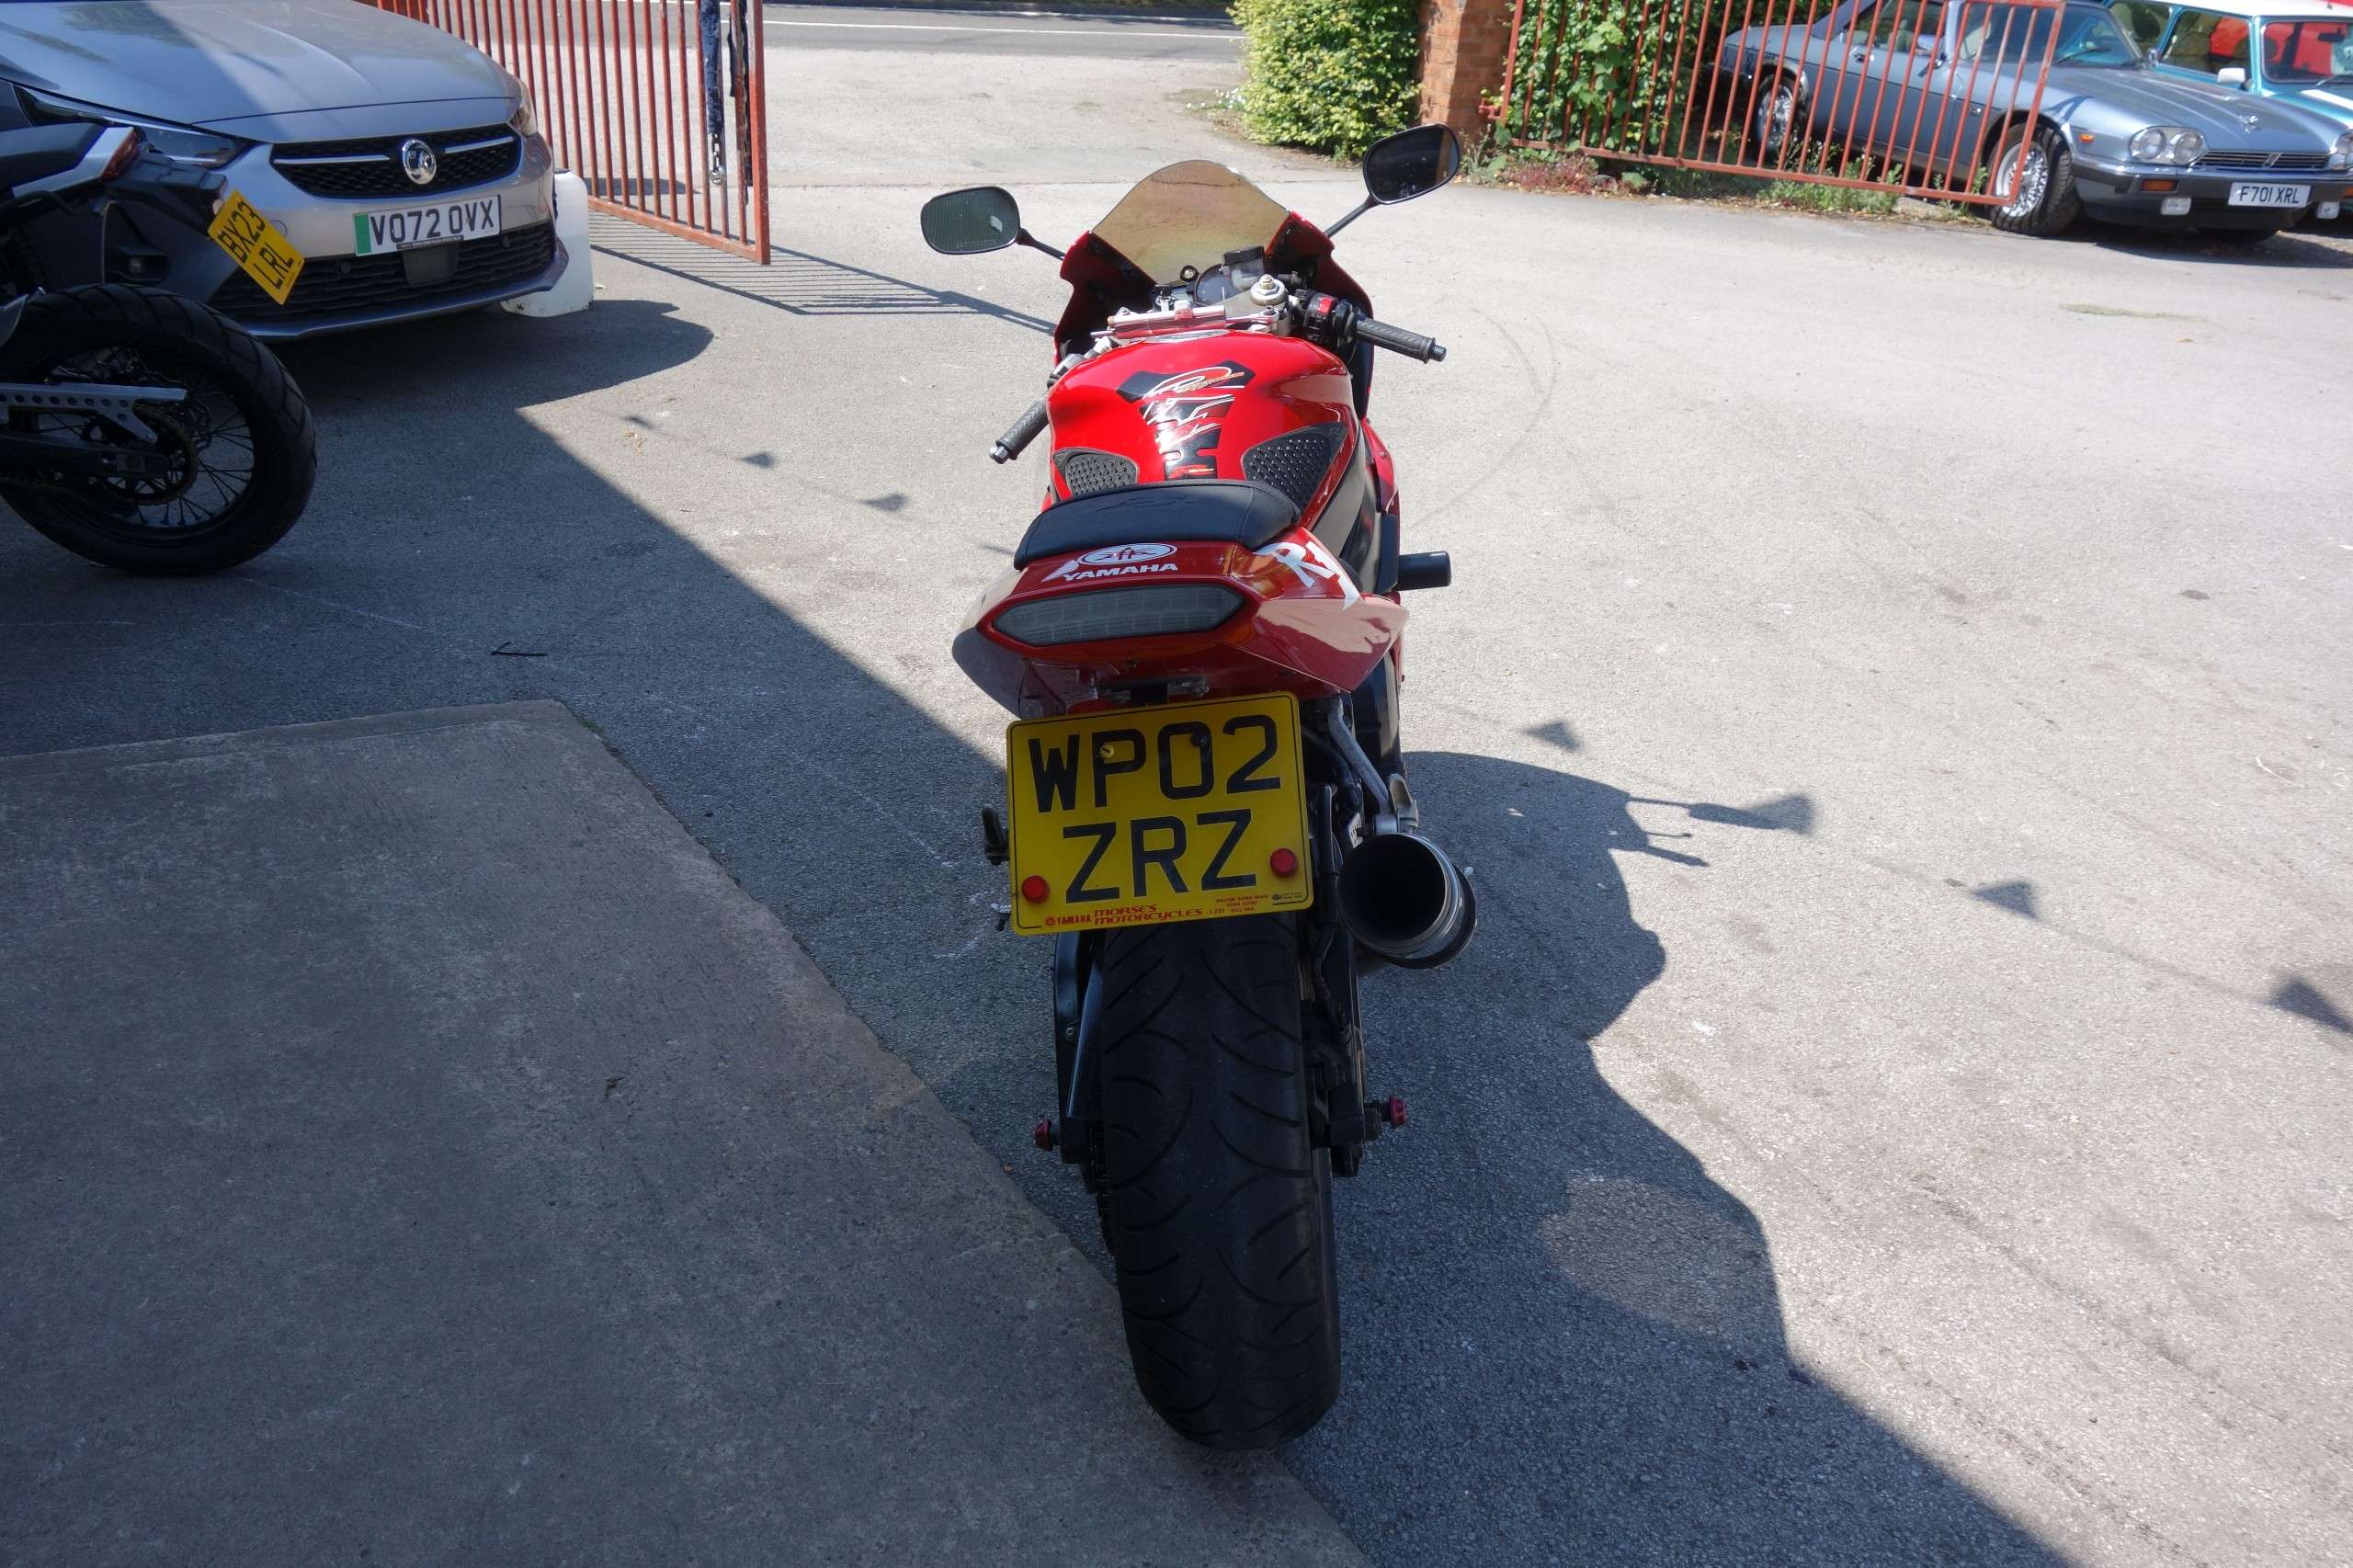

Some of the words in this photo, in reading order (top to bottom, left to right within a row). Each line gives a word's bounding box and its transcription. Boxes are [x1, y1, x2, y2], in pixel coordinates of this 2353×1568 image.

[2239, 186, 2273, 203] F701
[2275, 187, 2300, 204] XRL
[217, 200, 266, 264] BX23
[448, 199, 494, 235] OVX
[252, 242, 295, 290] LRL
[1062, 562, 1178, 582] YAMAHA
[1028, 713, 1281, 813] WP02
[1063, 808, 1256, 904] ZRZ
[1056, 913, 1092, 925] YAMAHA
[1094, 903, 1158, 917] MORSES
[1094, 908, 1203, 926] MOTORCYCLES
